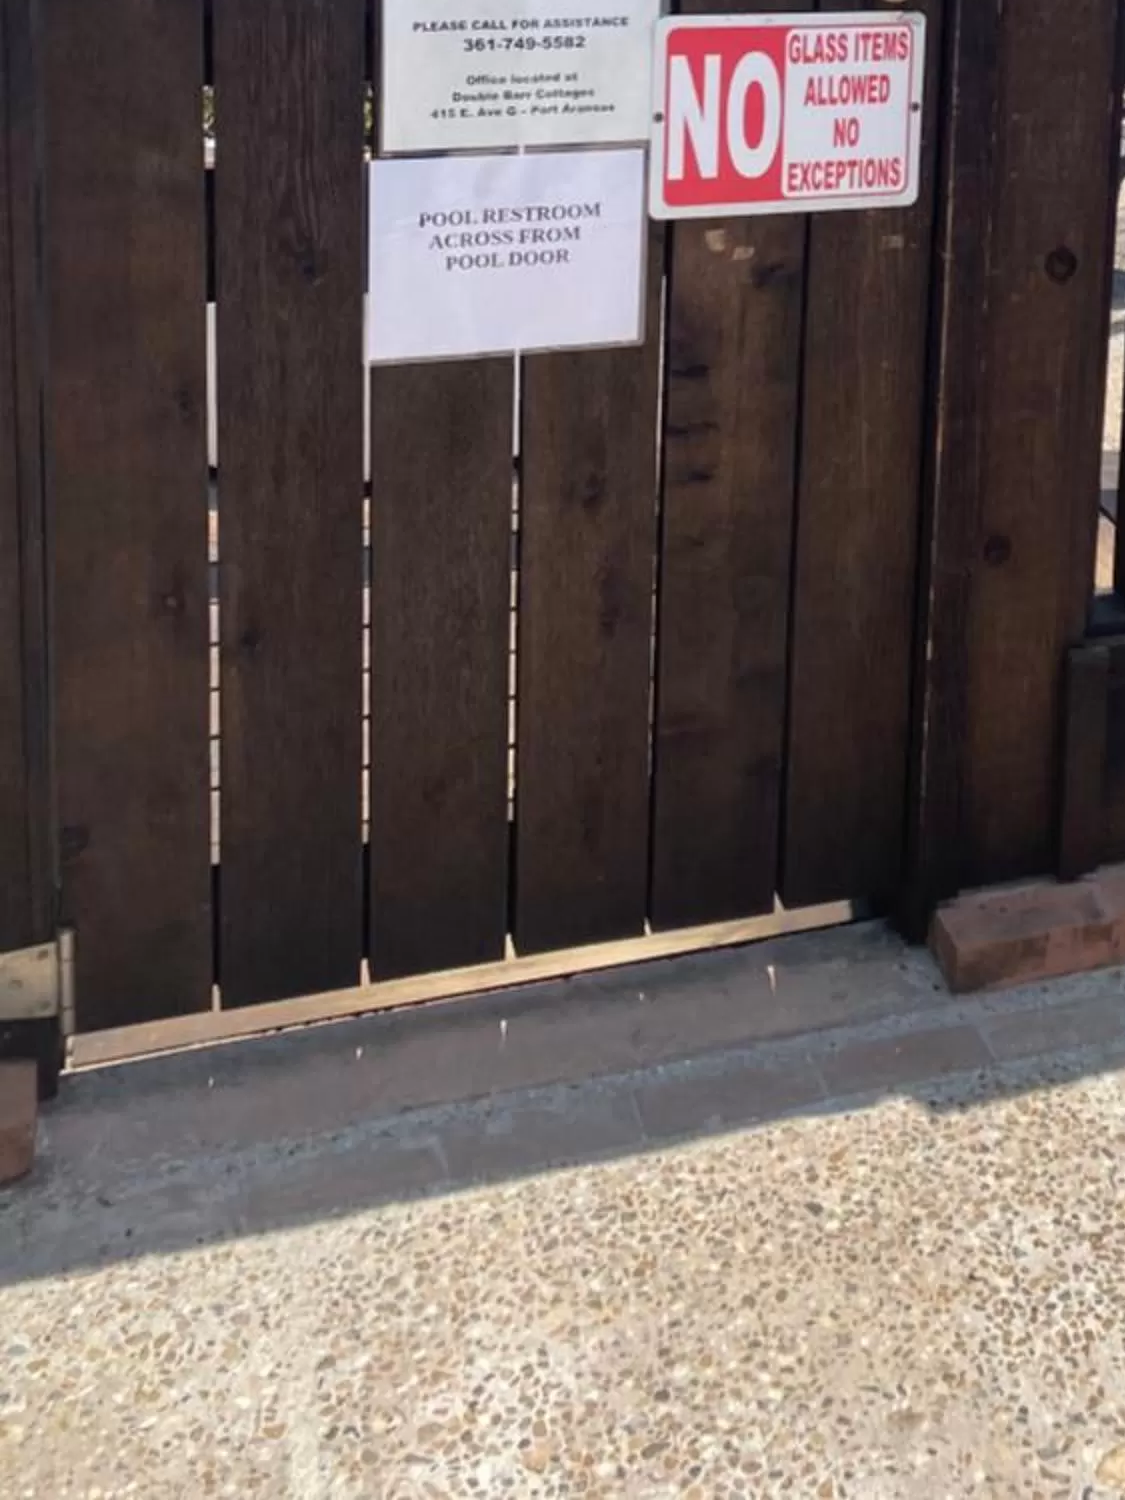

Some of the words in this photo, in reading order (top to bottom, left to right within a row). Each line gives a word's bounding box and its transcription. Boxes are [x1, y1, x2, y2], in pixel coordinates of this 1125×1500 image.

[412, 19, 466, 32] PLEASE
[471, 19, 507, 31] CALL
[511, 18, 539, 30] FOR
[543, 16, 629, 29] ASSISTANCE
[463, 36, 586, 52] 361-749-5582
[788, 33, 849, 64] GLASS
[853, 31, 909, 62] ITEMS
[466, 75, 507, 86] Office
[510, 73, 561, 85] located
[565, 73, 578, 83] at
[803, 73, 891, 106] ALLOWED
[452, 91, 499, 103] Double
[535, 88, 595, 101] Cottages
[477, 107, 502, 117] Ave
[667, 51, 782, 181] NO
[833, 117, 860, 147] NO
[787, 157, 901, 192] EXCEPTIONS
[419, 210, 478, 228] POOL
[482, 202, 602, 225] RESTROOM
[429, 229, 514, 250] ACROSS
[518, 225, 581, 244] FROM
[446, 252, 505, 271] POOL
[508, 249, 570, 267] DOOR
